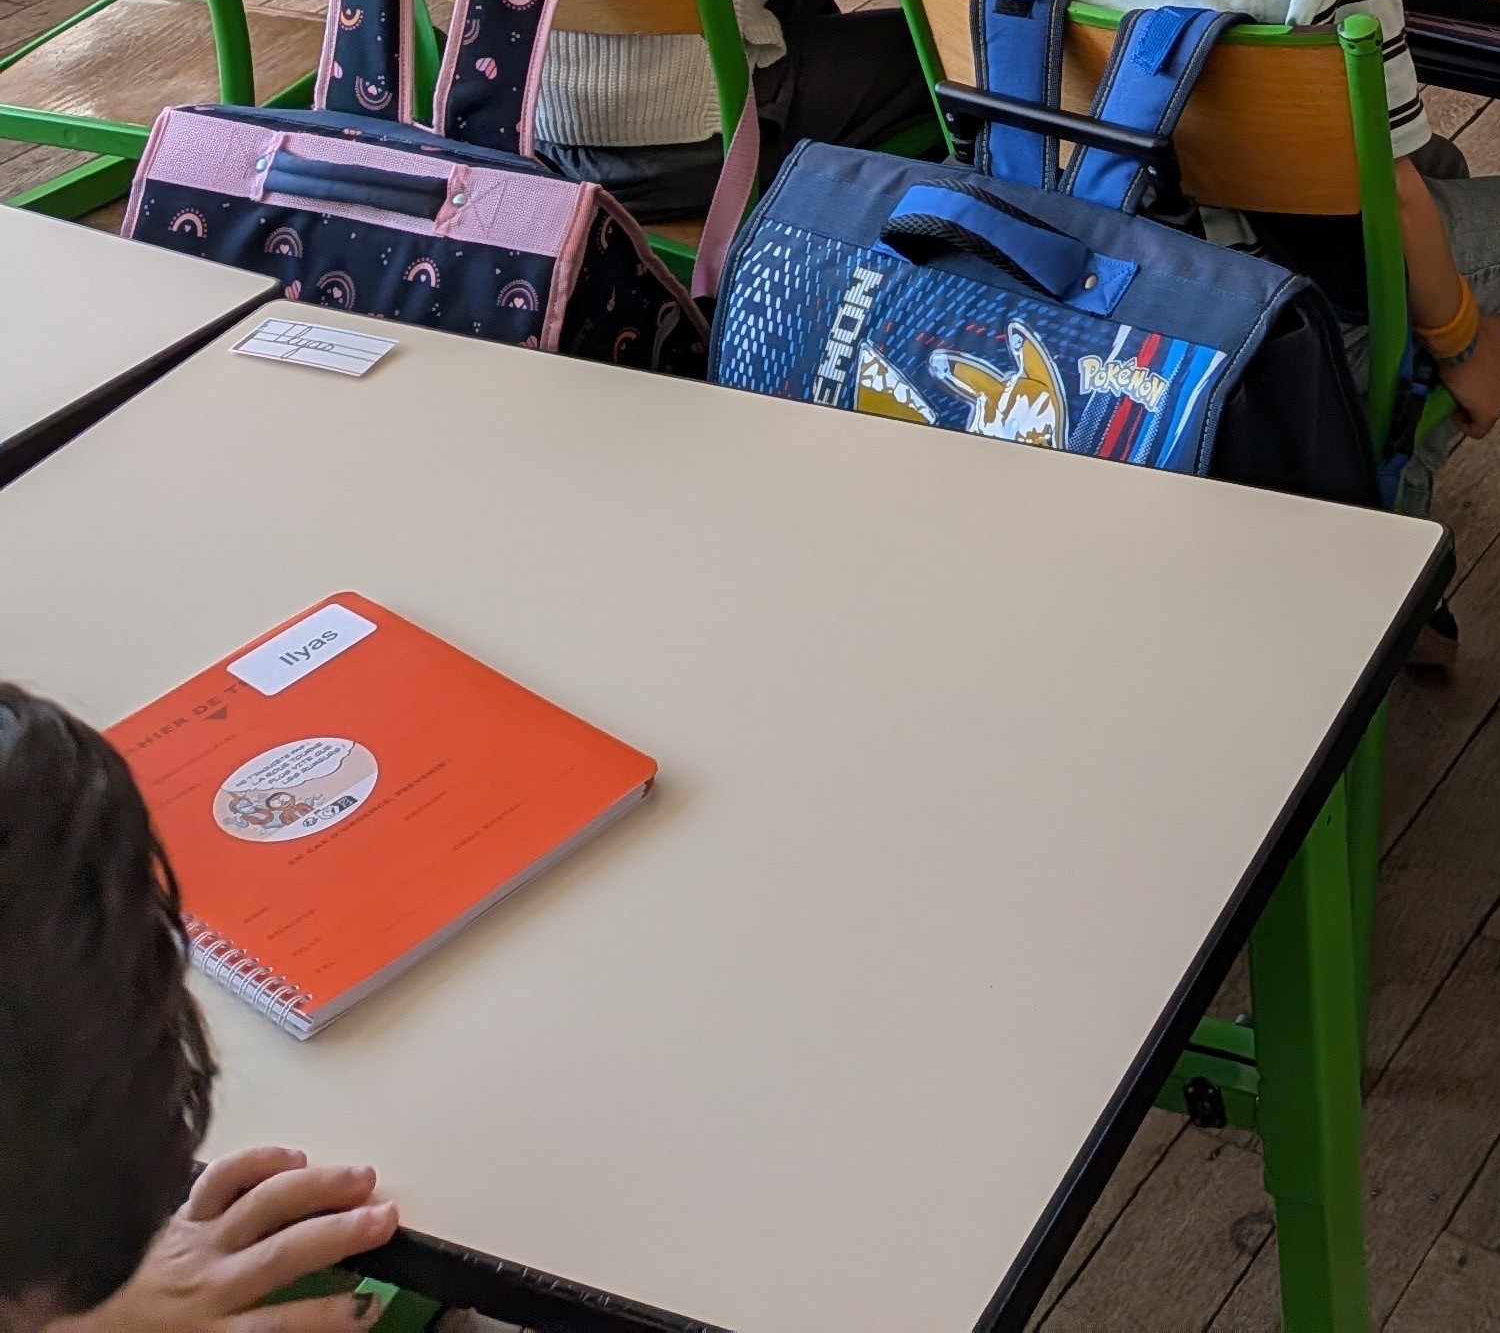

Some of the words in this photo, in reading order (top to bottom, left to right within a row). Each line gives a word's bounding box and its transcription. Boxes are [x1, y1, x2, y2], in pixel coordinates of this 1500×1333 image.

[279, 628, 339, 667] Ilyas
[251, 775, 266, 786] LA
[265, 761, 289, 778] ROUE
[289, 740, 323, 763] TOURNE
[267, 768, 291, 785] PLUS
[290, 755, 313, 770] VITE
[313, 743, 332, 757] QUE
[281, 771, 300, 784] LES
